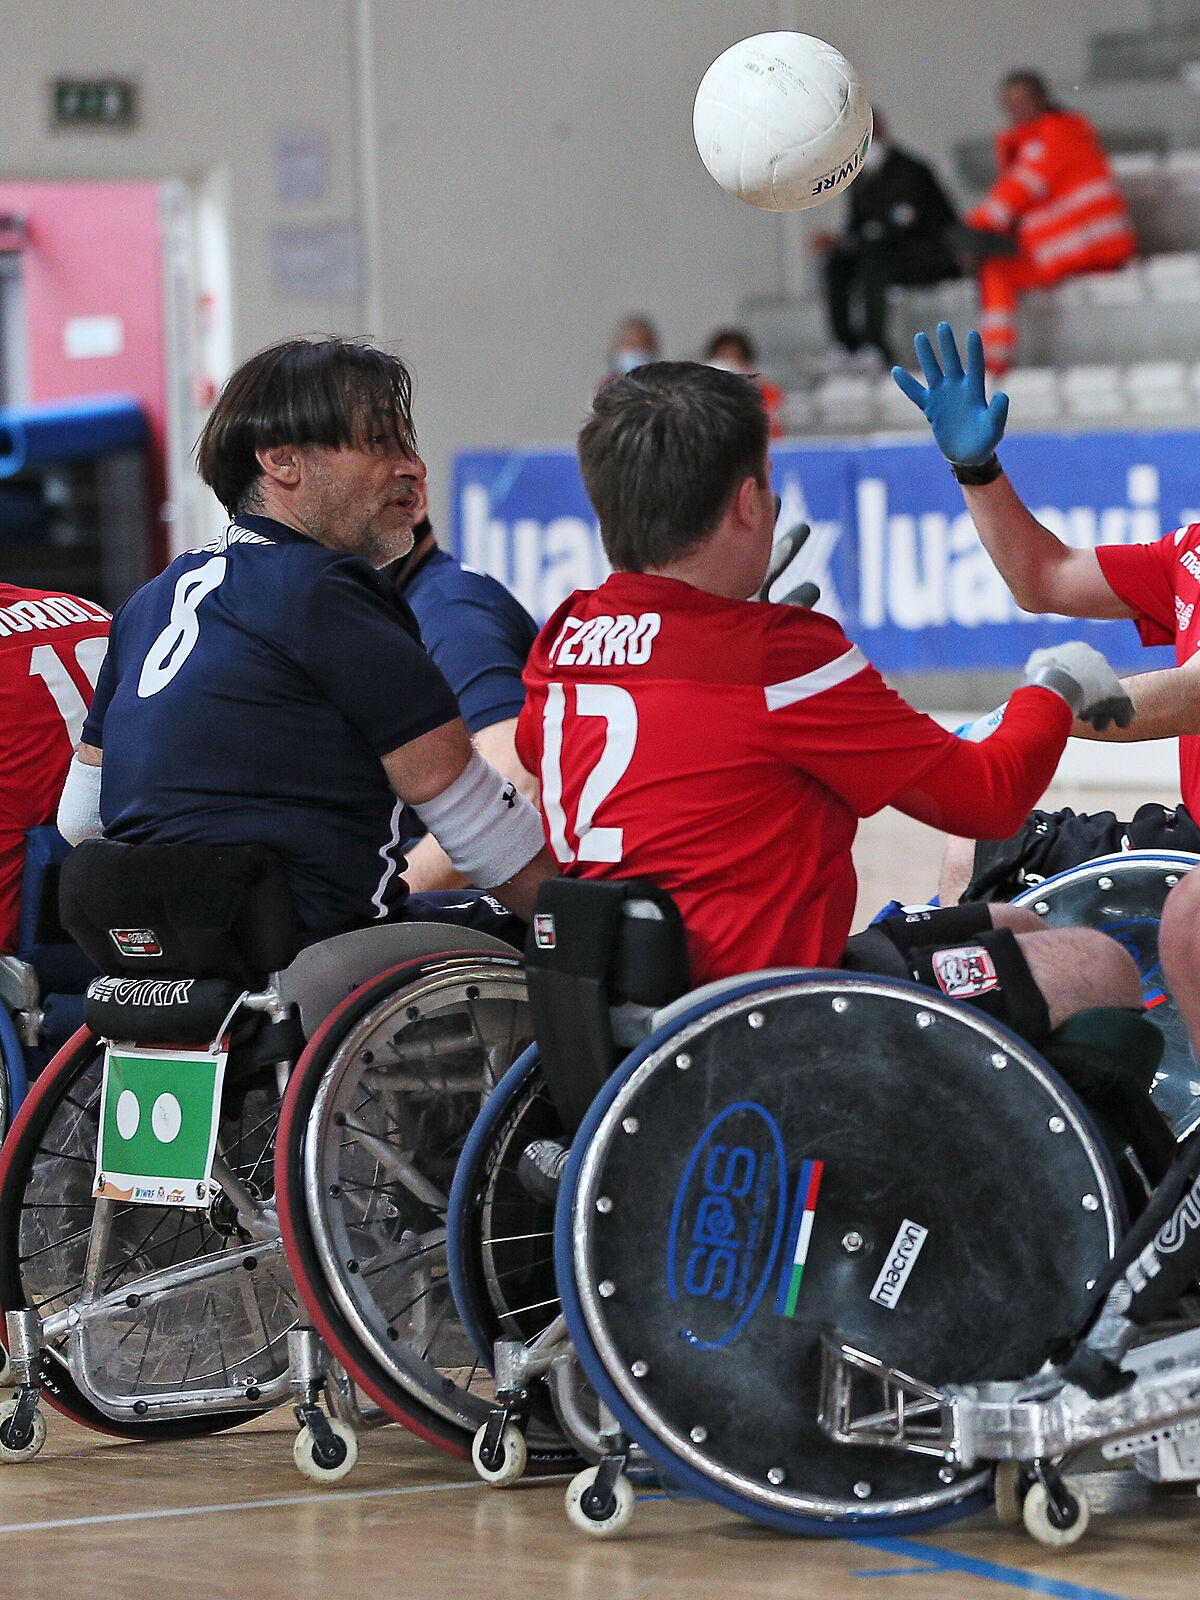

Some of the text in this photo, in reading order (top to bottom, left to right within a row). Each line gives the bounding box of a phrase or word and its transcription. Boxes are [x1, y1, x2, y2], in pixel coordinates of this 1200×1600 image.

[811, 153, 858, 196] IWRF
[136, 554, 228, 699] 8
[541, 682, 638, 864] 12
[684, 1145, 757, 1301] SPS
[876, 1223, 922, 1304] macron
